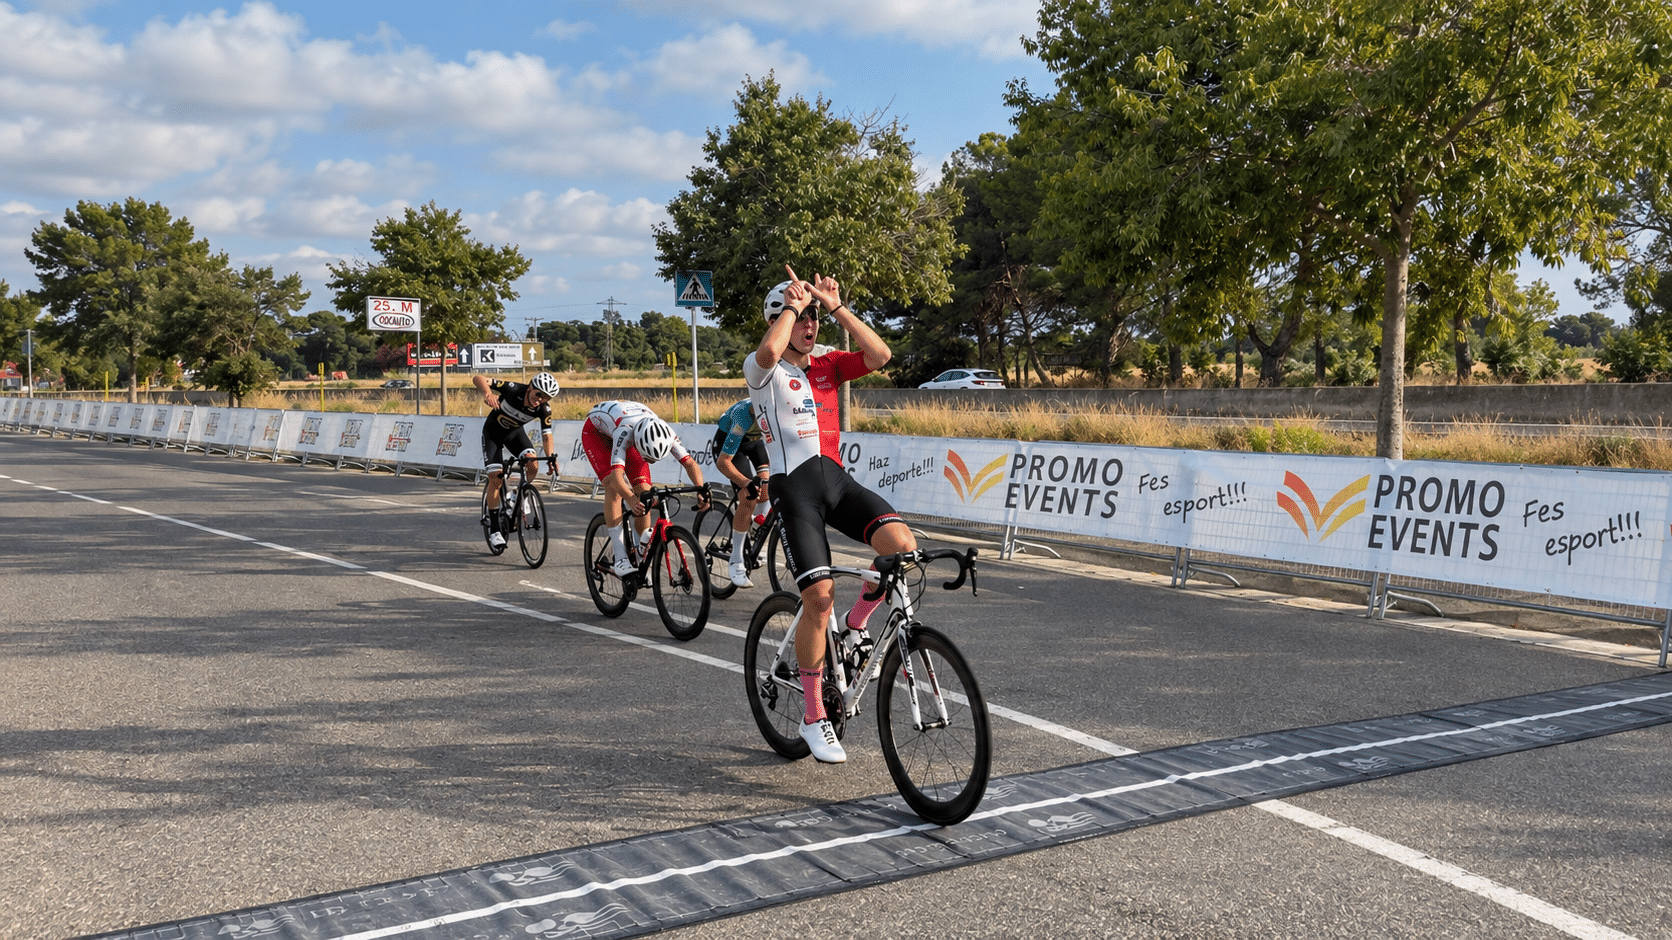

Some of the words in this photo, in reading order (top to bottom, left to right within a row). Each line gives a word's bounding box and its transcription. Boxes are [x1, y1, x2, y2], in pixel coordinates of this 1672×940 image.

[401, 302, 413, 313] M
[869, 456, 889, 471] Haz
[878, 456, 934, 492] deporte!!!
[1010, 453, 1123, 487] PROMO
[1005, 483, 1119, 519] EVENTS
[1138, 473, 1169, 495] Fes
[1163, 481, 1248, 523] esport!!!
[1374, 474, 1506, 518] PROMO
[1523, 499, 1565, 528] Fes
[1367, 515, 1501, 562] EVENTS
[1545, 511, 1643, 566] esport!!!
